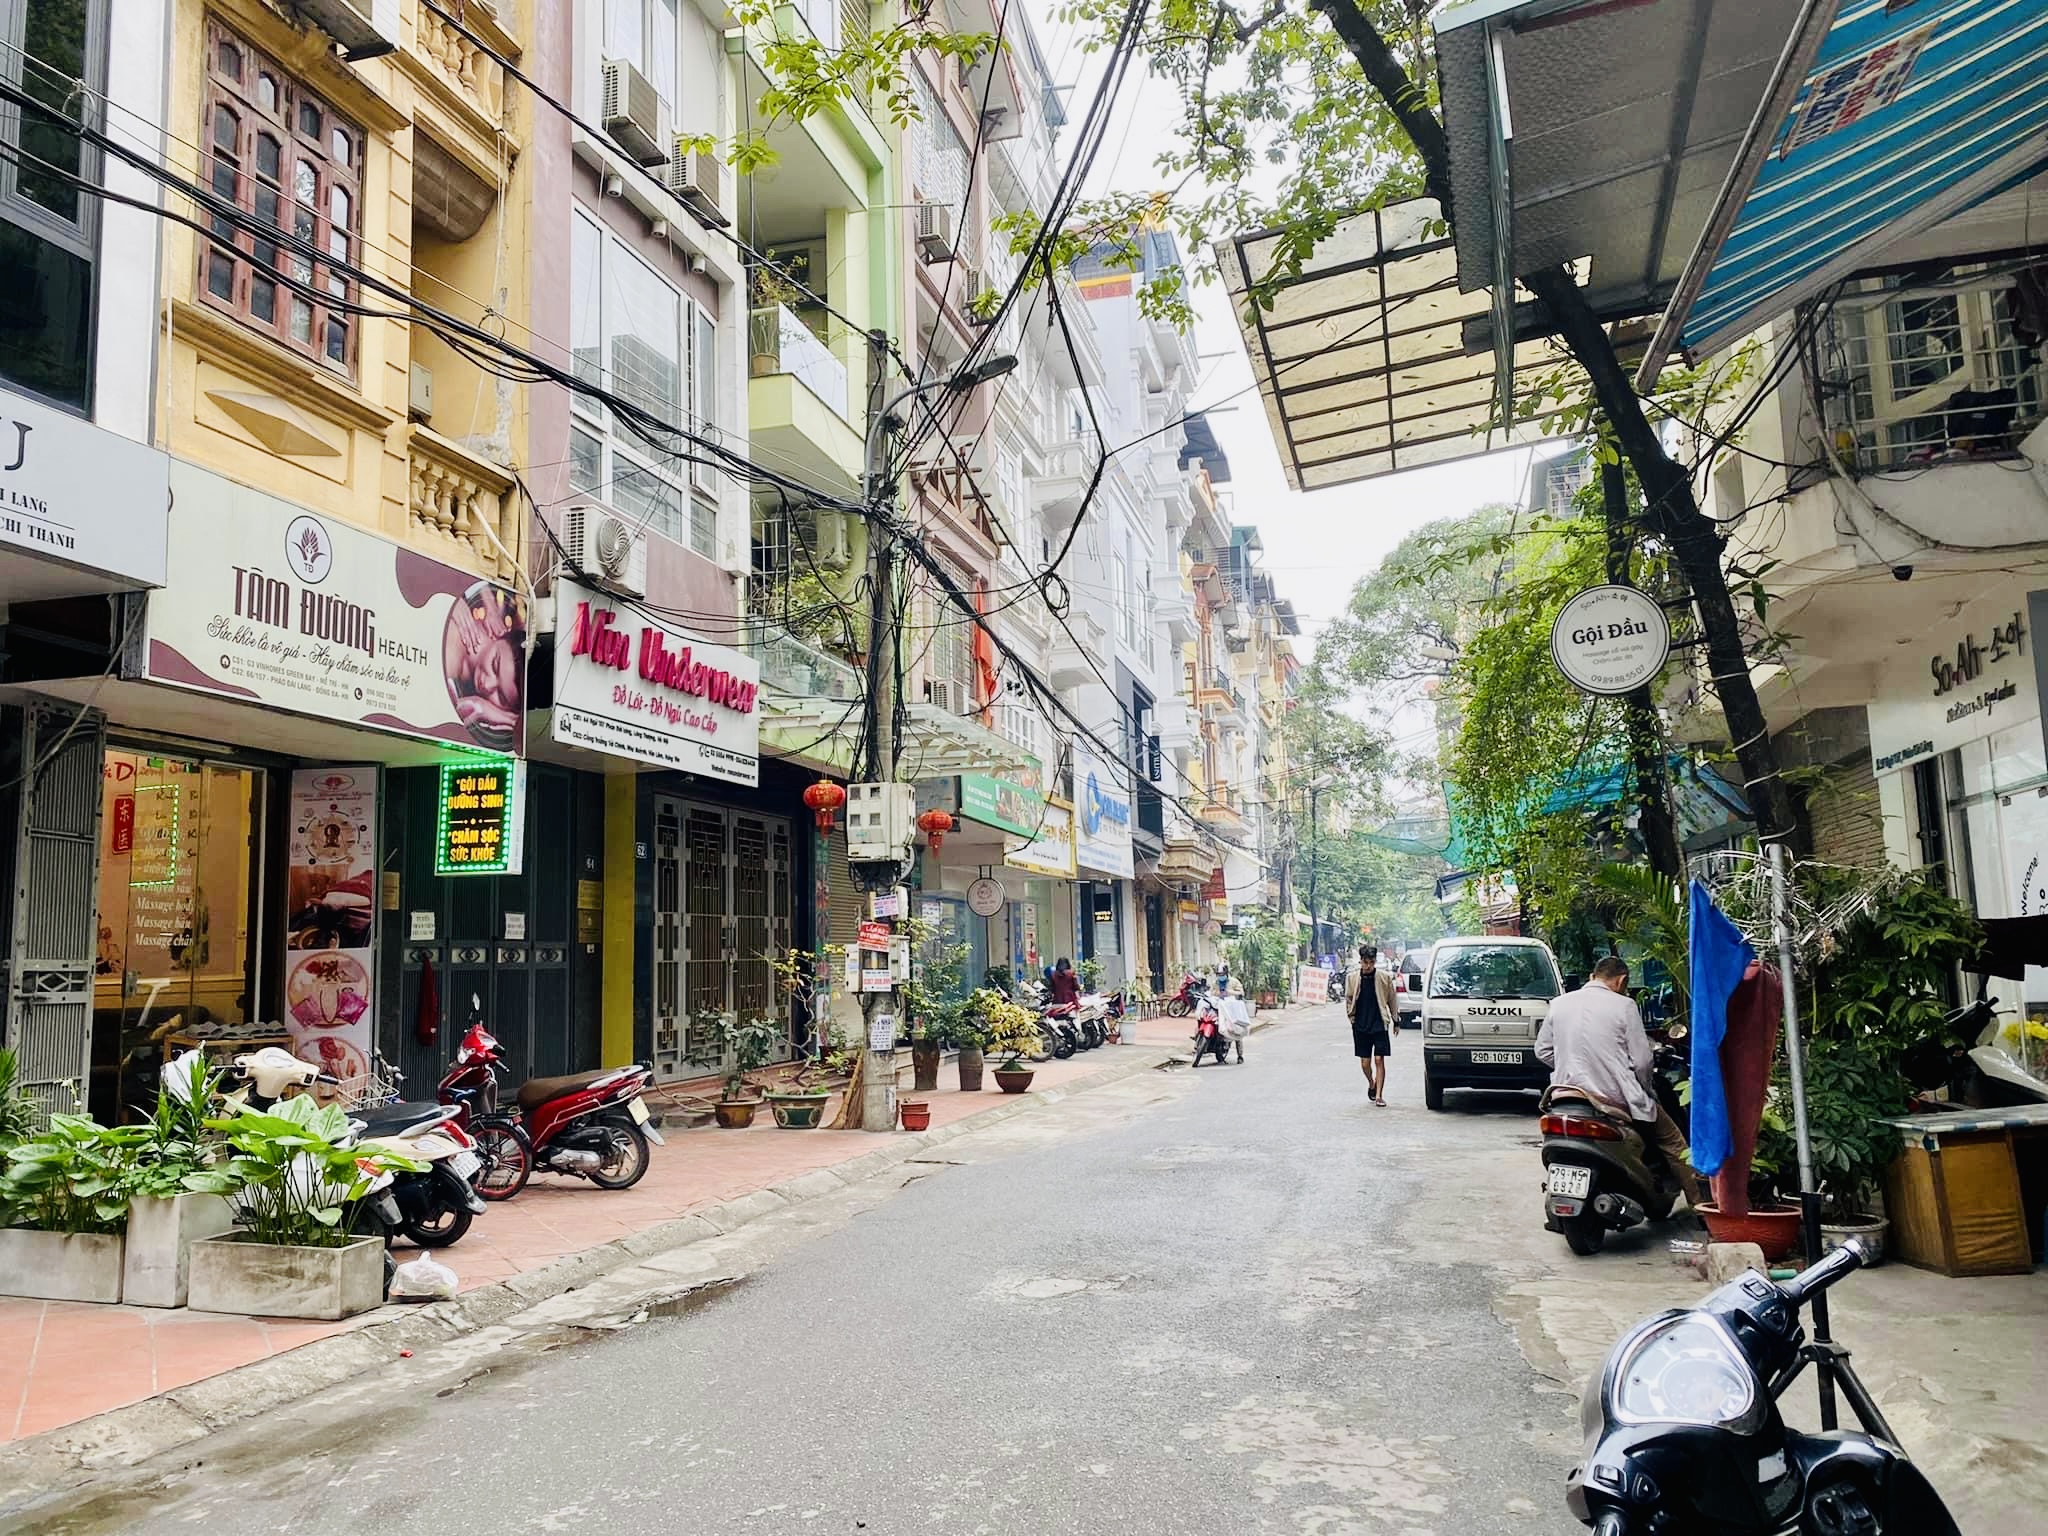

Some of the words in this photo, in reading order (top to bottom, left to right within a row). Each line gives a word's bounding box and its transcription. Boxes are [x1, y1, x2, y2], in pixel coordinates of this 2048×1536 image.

[12, 491, 48, 514] LANG
[27, 524, 75, 549] THANH
[232, 565, 290, 629] TÂM
[300, 588, 376, 659] ĐƯỜNG
[378, 637, 428, 666] HEALTH
[1572, 625, 1604, 646] Gội
[1608, 617, 1648, 640] Đầu
[639, 627, 758, 713] Underwear
[683, 709, 700, 728] Cao
[702, 712, 717, 735] Cấp
[480, 794, 504, 808] SINH
[480, 826, 500, 843] SÓC
[1467, 1007, 1522, 1016] SUZUKI
